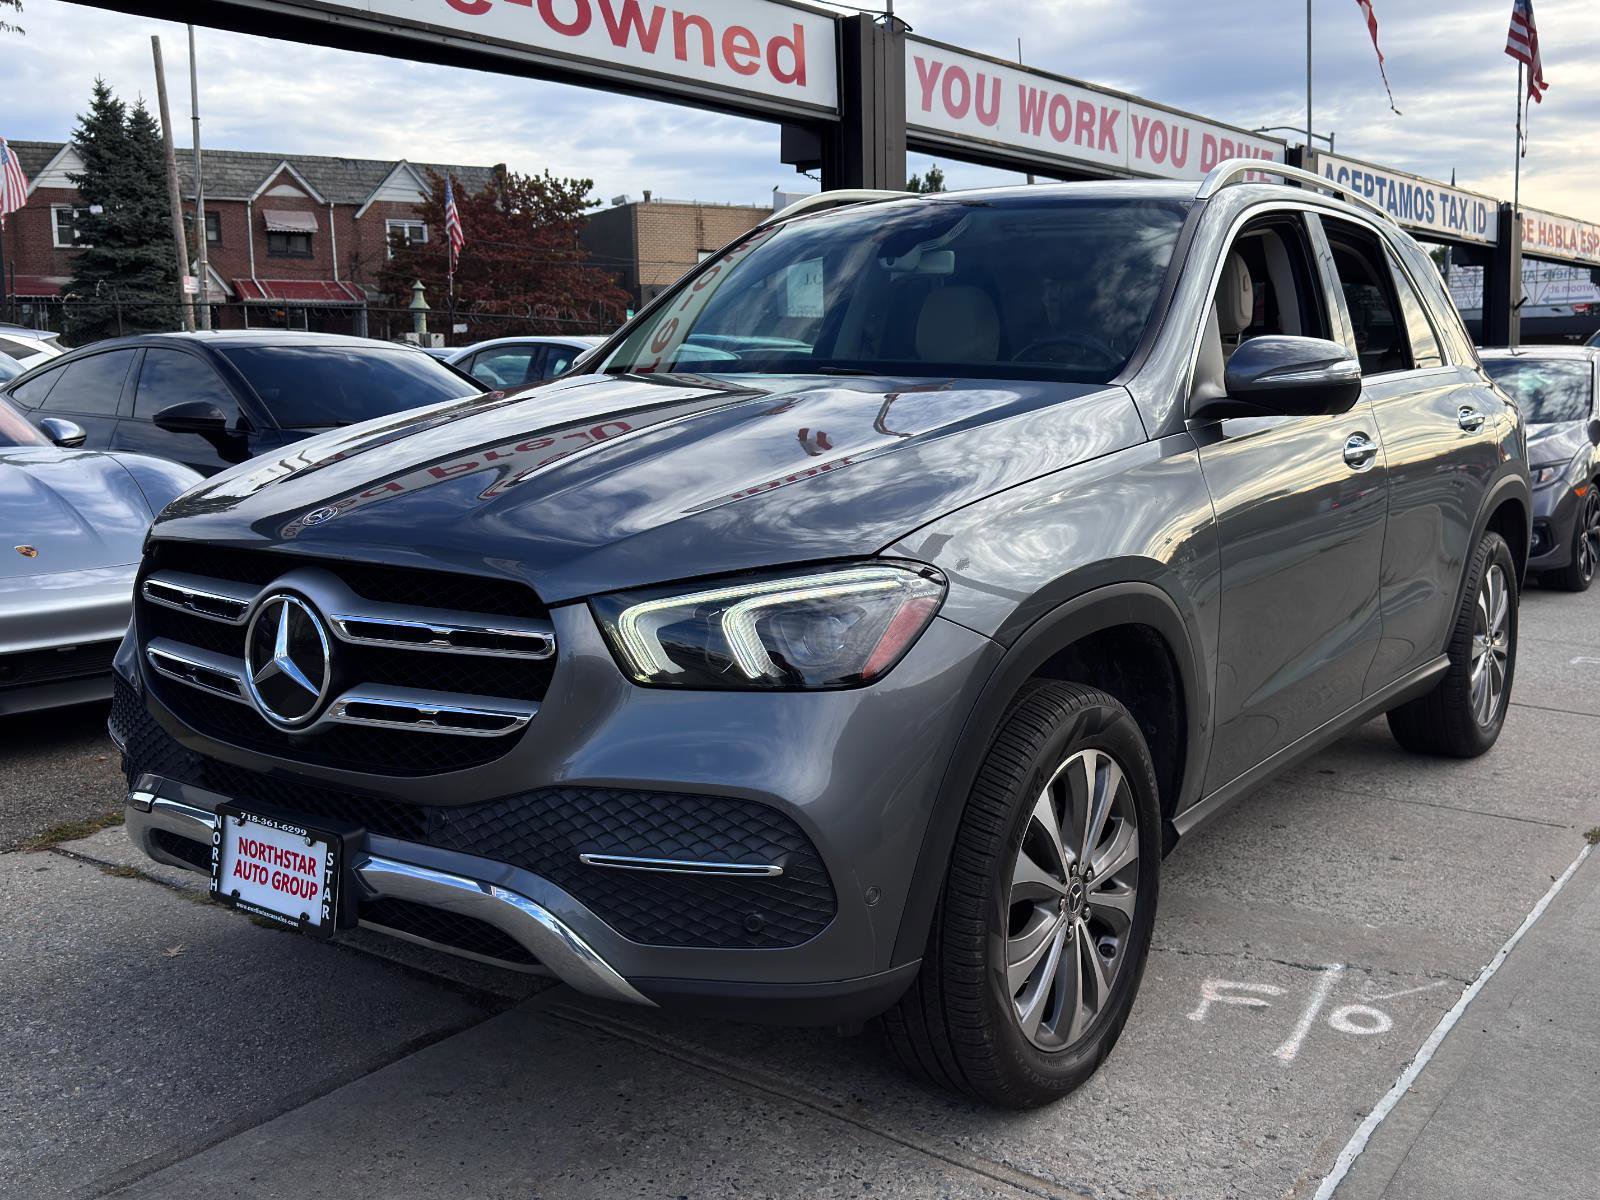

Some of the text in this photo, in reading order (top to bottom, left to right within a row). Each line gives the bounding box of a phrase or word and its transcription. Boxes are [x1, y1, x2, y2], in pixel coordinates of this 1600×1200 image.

[913, 55, 1002, 127] YOU
[1018, 84, 1120, 154] WORK
[1131, 113, 1189, 169] YOU
[1440, 193, 1467, 232] TAX
[1473, 200, 1487, 234] ID
[1538, 221, 1577, 251] HABLA
[1580, 230, 1600, 256] ESP
[210, 814, 222, 892] NORTH
[238, 836, 317, 878] NORTHSTAR
[233, 859, 319, 901] AUTO GROUP
[322, 852, 334, 920] STAR
